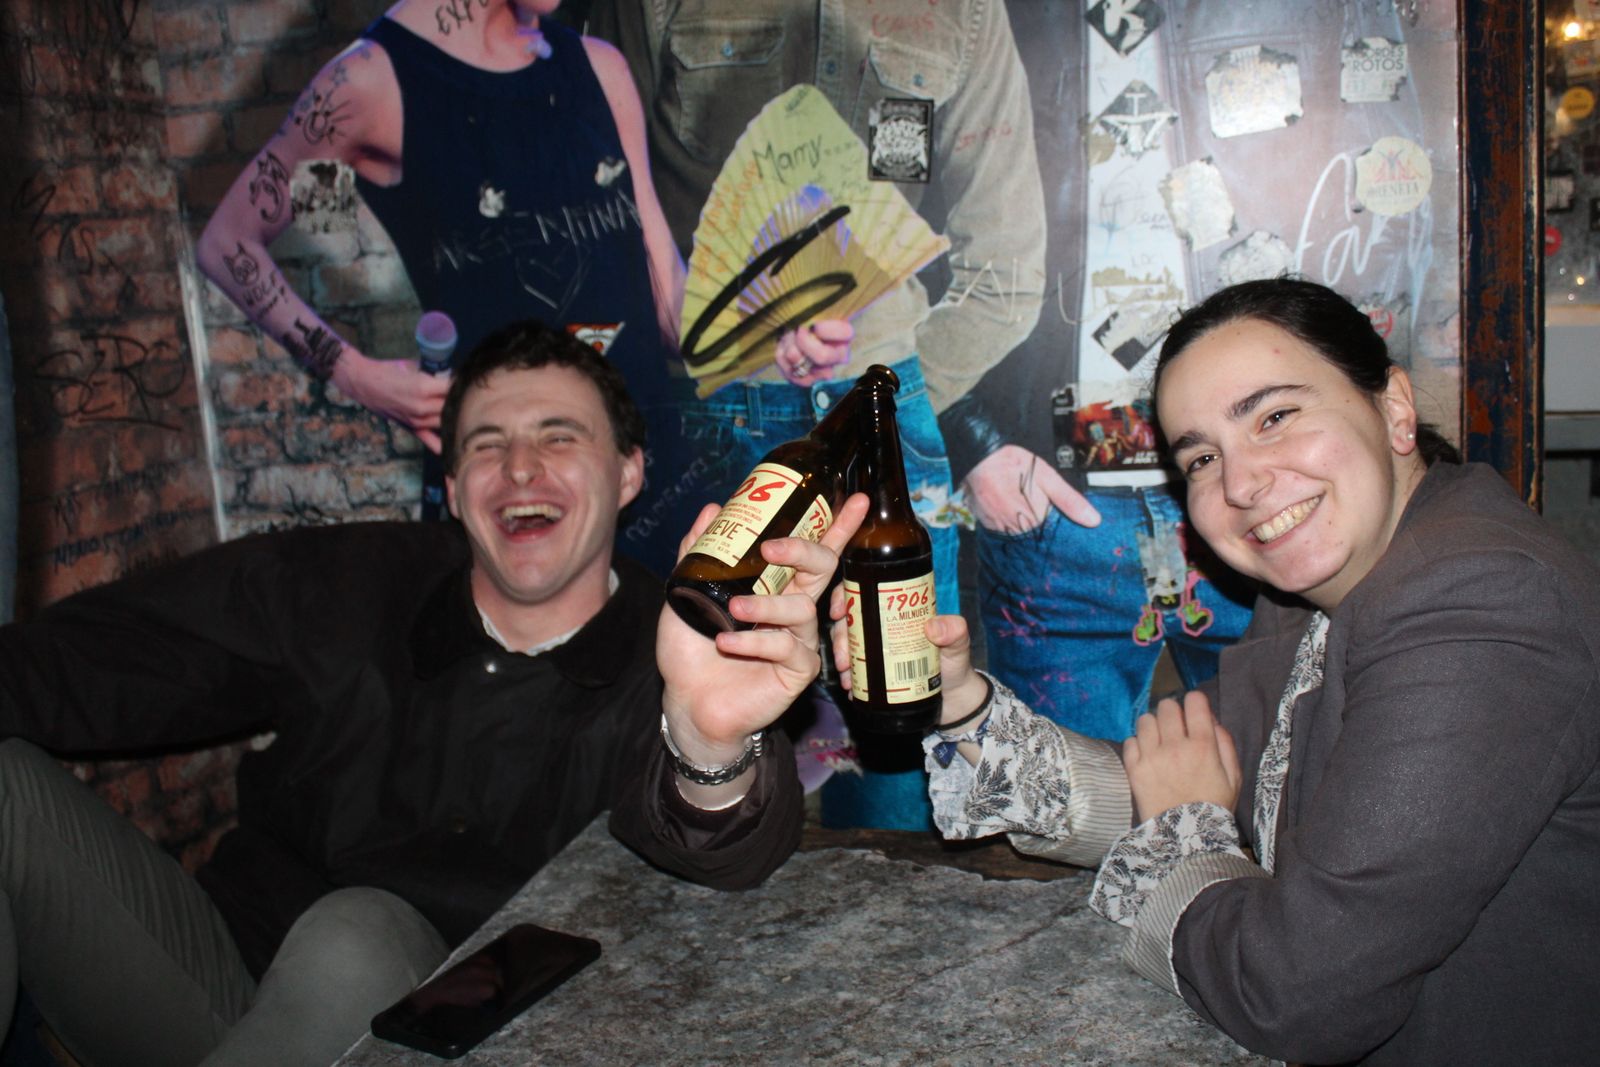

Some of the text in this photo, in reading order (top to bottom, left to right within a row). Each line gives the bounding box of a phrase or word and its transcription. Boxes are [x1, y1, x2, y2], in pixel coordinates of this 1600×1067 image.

[1352, 57, 1404, 73] ROTOS
[730, 476, 787, 502] 06
[706, 519, 743, 541] UEVE
[886, 586, 929, 612] 1906
[886, 607, 930, 623] LA MILNUEVE
